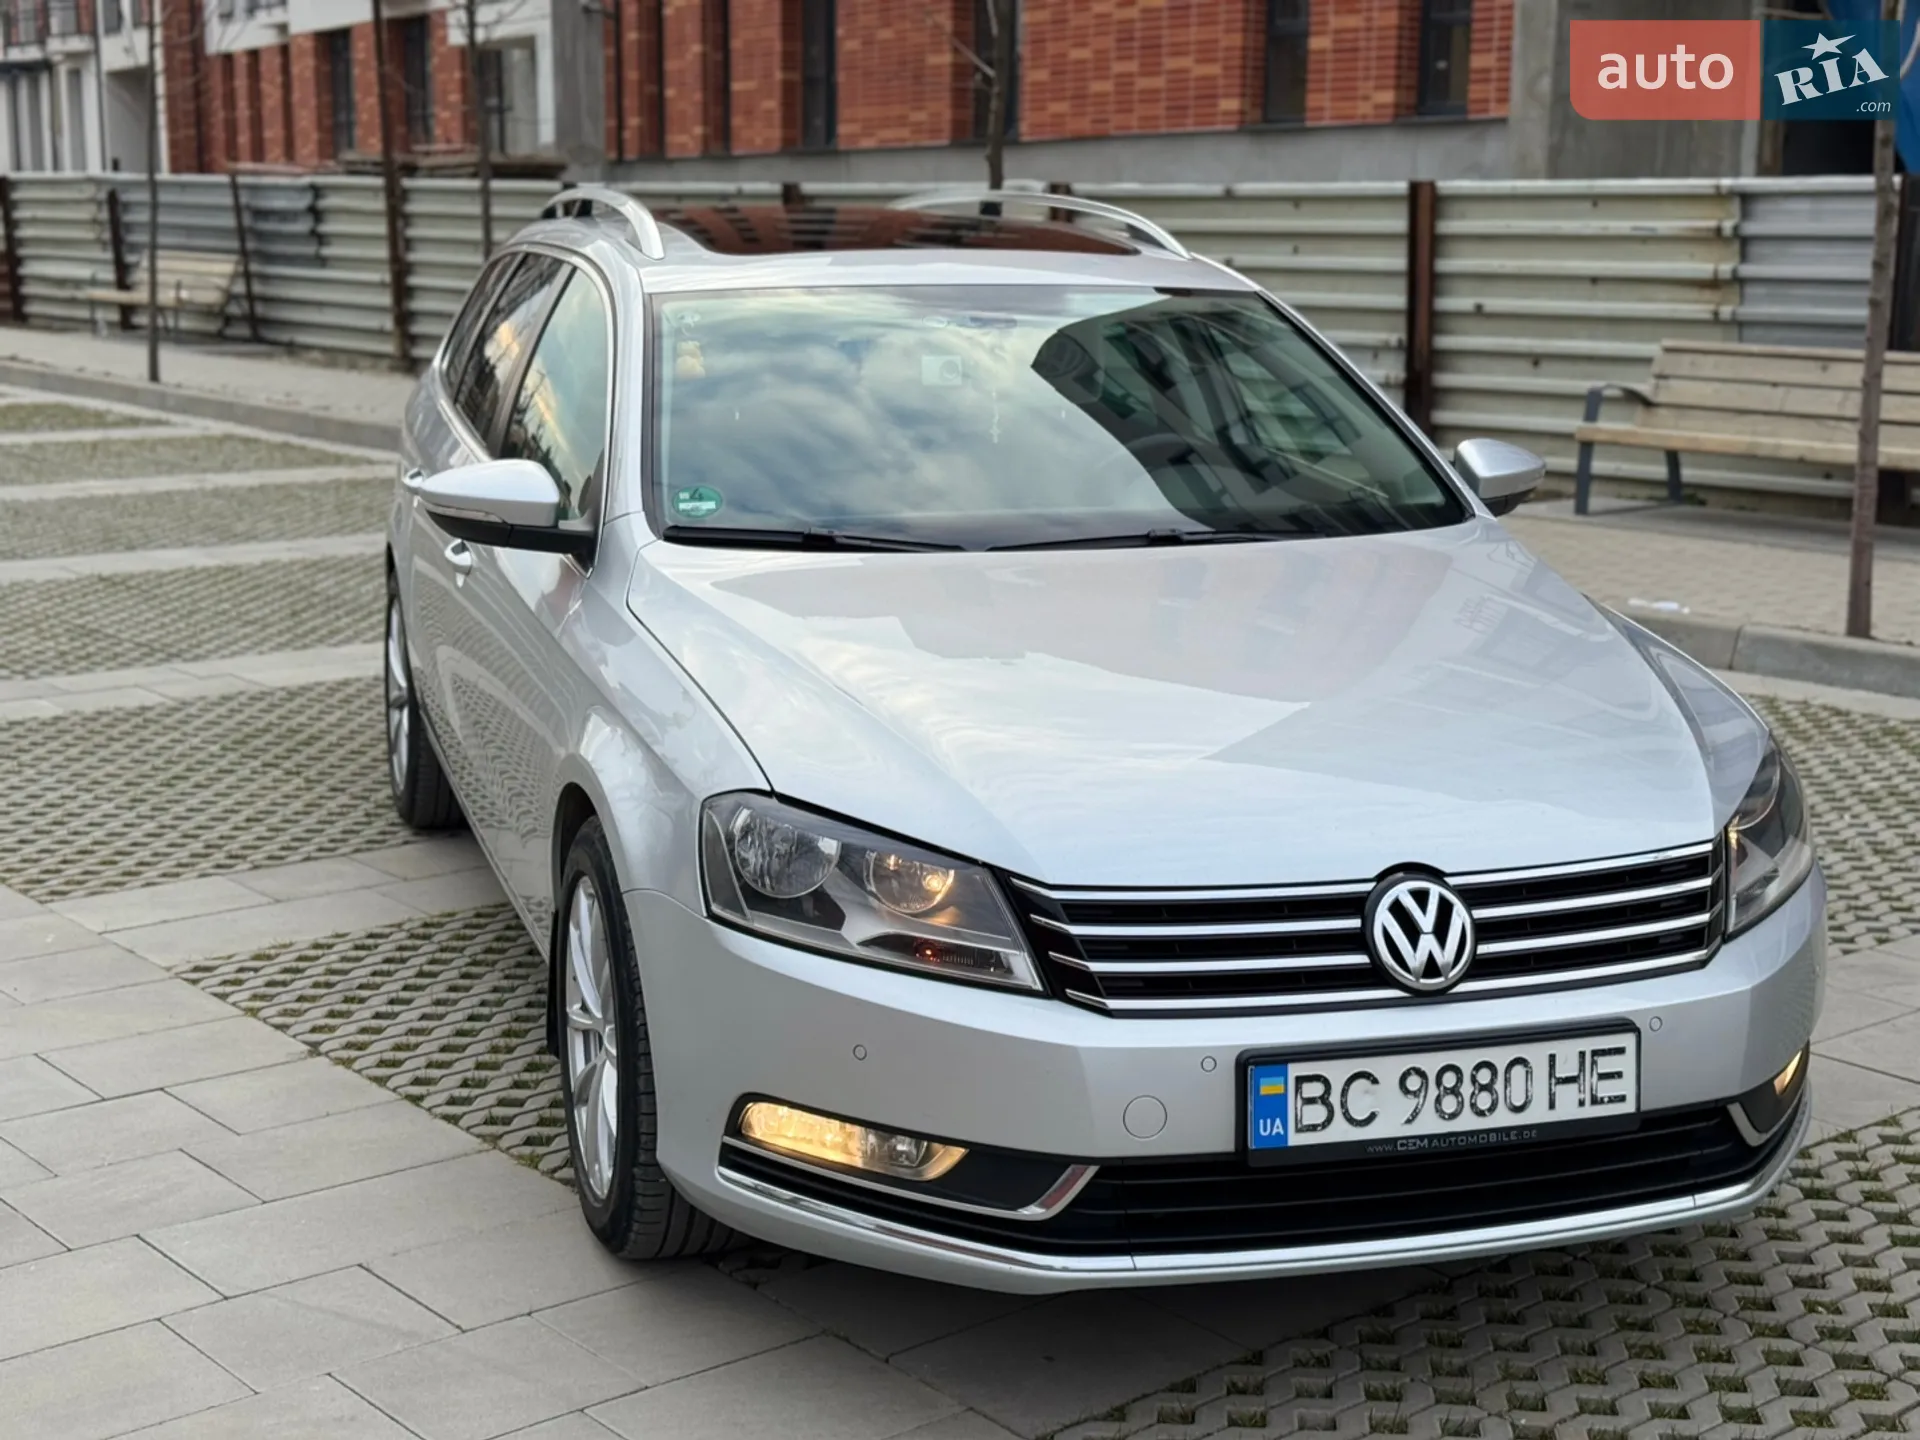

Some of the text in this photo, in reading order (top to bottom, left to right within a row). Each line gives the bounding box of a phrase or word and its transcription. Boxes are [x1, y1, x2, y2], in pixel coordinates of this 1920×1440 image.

[1294, 1046, 1628, 1134] BC 9880 HE
[1258, 1117, 1285, 1137] UA
